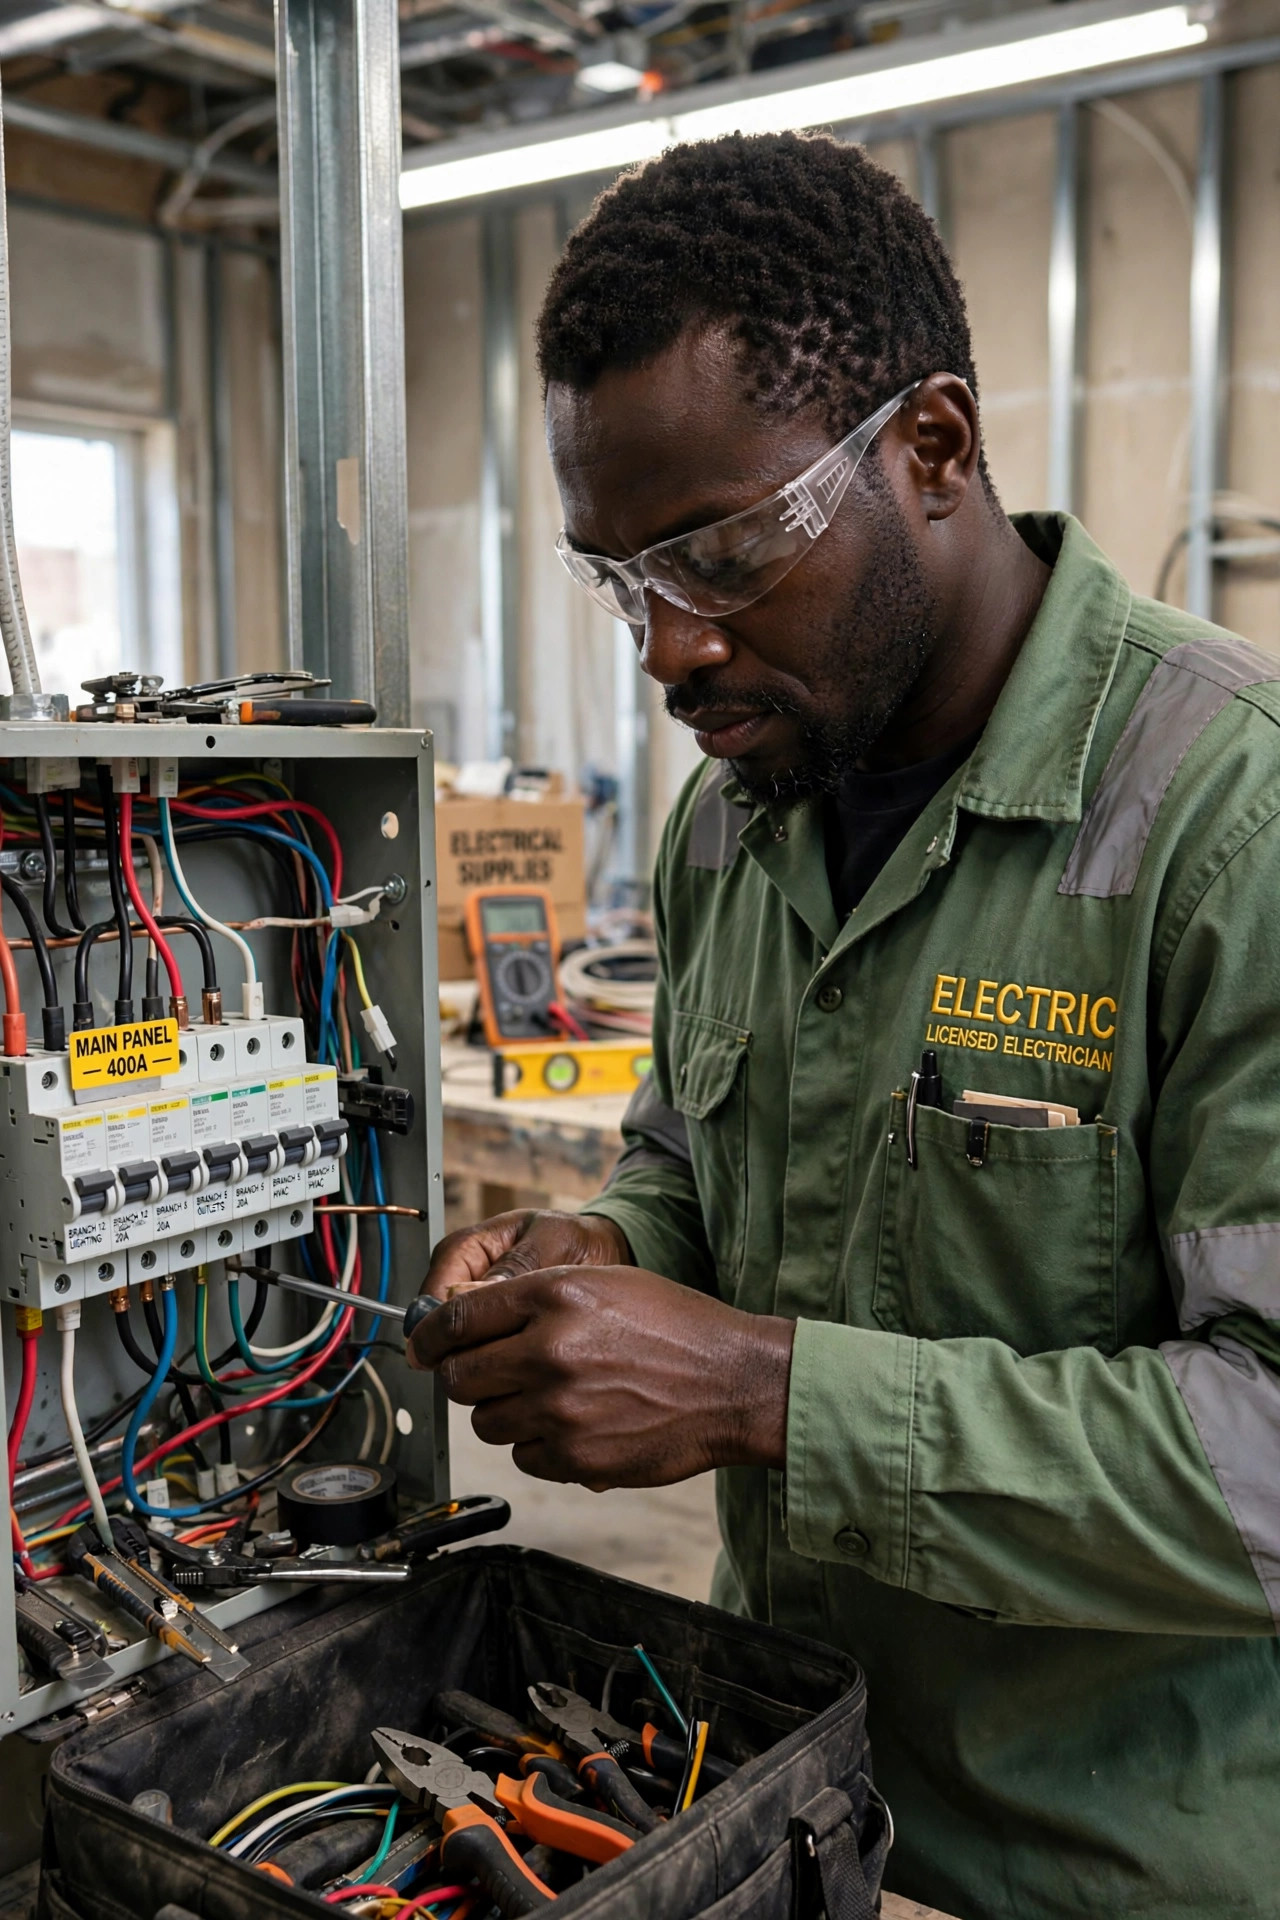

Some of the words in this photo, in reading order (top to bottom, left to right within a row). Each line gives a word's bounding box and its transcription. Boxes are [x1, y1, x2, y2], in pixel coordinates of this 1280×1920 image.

[450, 829, 563, 855] ELECTRICAL
[459, 857, 553, 885] SUPPLIES
[931, 974, 1117, 1039] ELECTRIC
[76, 1033, 117, 1058] MAIN
[123, 1025, 172, 1050] PANEL
[926, 1024, 998, 1051] LICENSED
[1002, 1035, 1113, 1072] ELECTRICIAN
[107, 1054, 148, 1076] 400A
